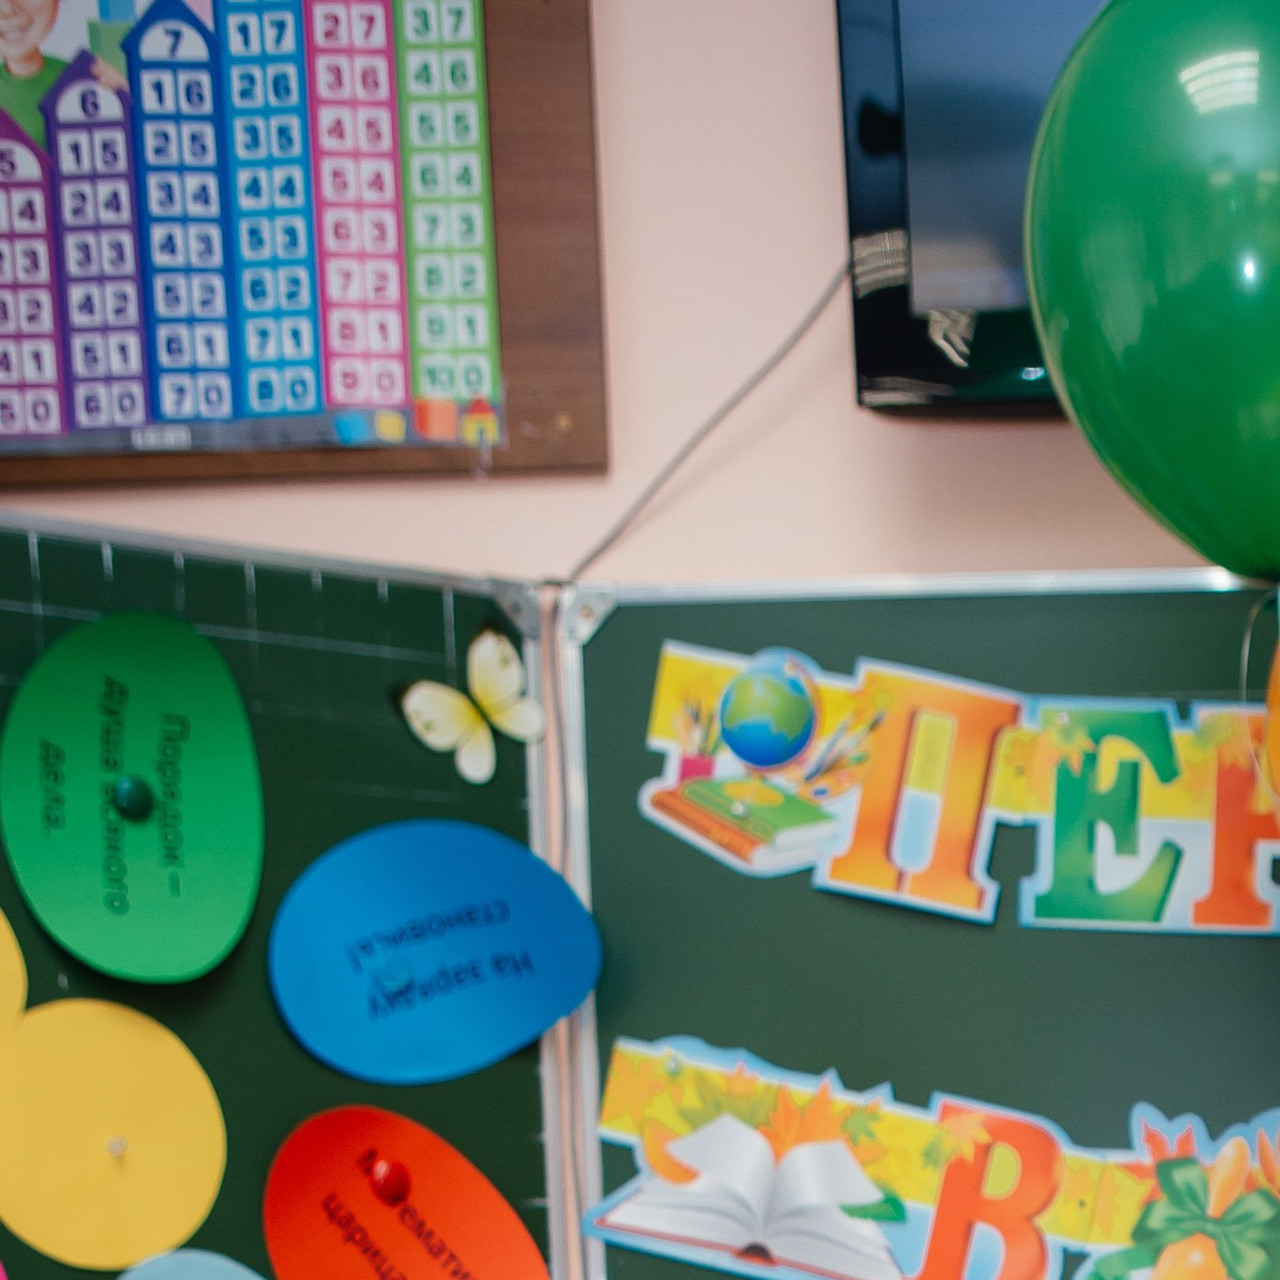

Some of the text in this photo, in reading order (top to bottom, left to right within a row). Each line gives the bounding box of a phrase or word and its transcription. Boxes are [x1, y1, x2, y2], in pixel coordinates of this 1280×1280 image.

[237, 18, 287, 49] 1 7
[324, 14, 375, 41] 2 7
[414, 7, 464, 35] 3 7
[165, 29, 182, 59] 7
[327, 65, 380, 95] 3 6
[415, 61, 467, 85] 4 6
[152, 80, 204, 106] 1 6
[239, 71, 291, 103] 2 6
[80, 90, 99, 120] 6
[243, 122, 294, 155] 3 5
[327, 118, 382, 146] 4 5
[419, 112, 470, 138] 5 5
[69, 139, 118, 169] 1 5
[154, 130, 207, 157] 2 5
[243, 175, 296, 199] 4 4
[332, 169, 385, 193] 5 4
[420, 164, 472, 189] 6 4
[72, 190, 122, 218] 2 4
[158, 182, 210, 207] 3 4
[19, 199, 37, 223] 4
[23, 249, 40, 275] 3
[76, 240, 126, 270] 3 3
[27, 298, 42, 324] 2
